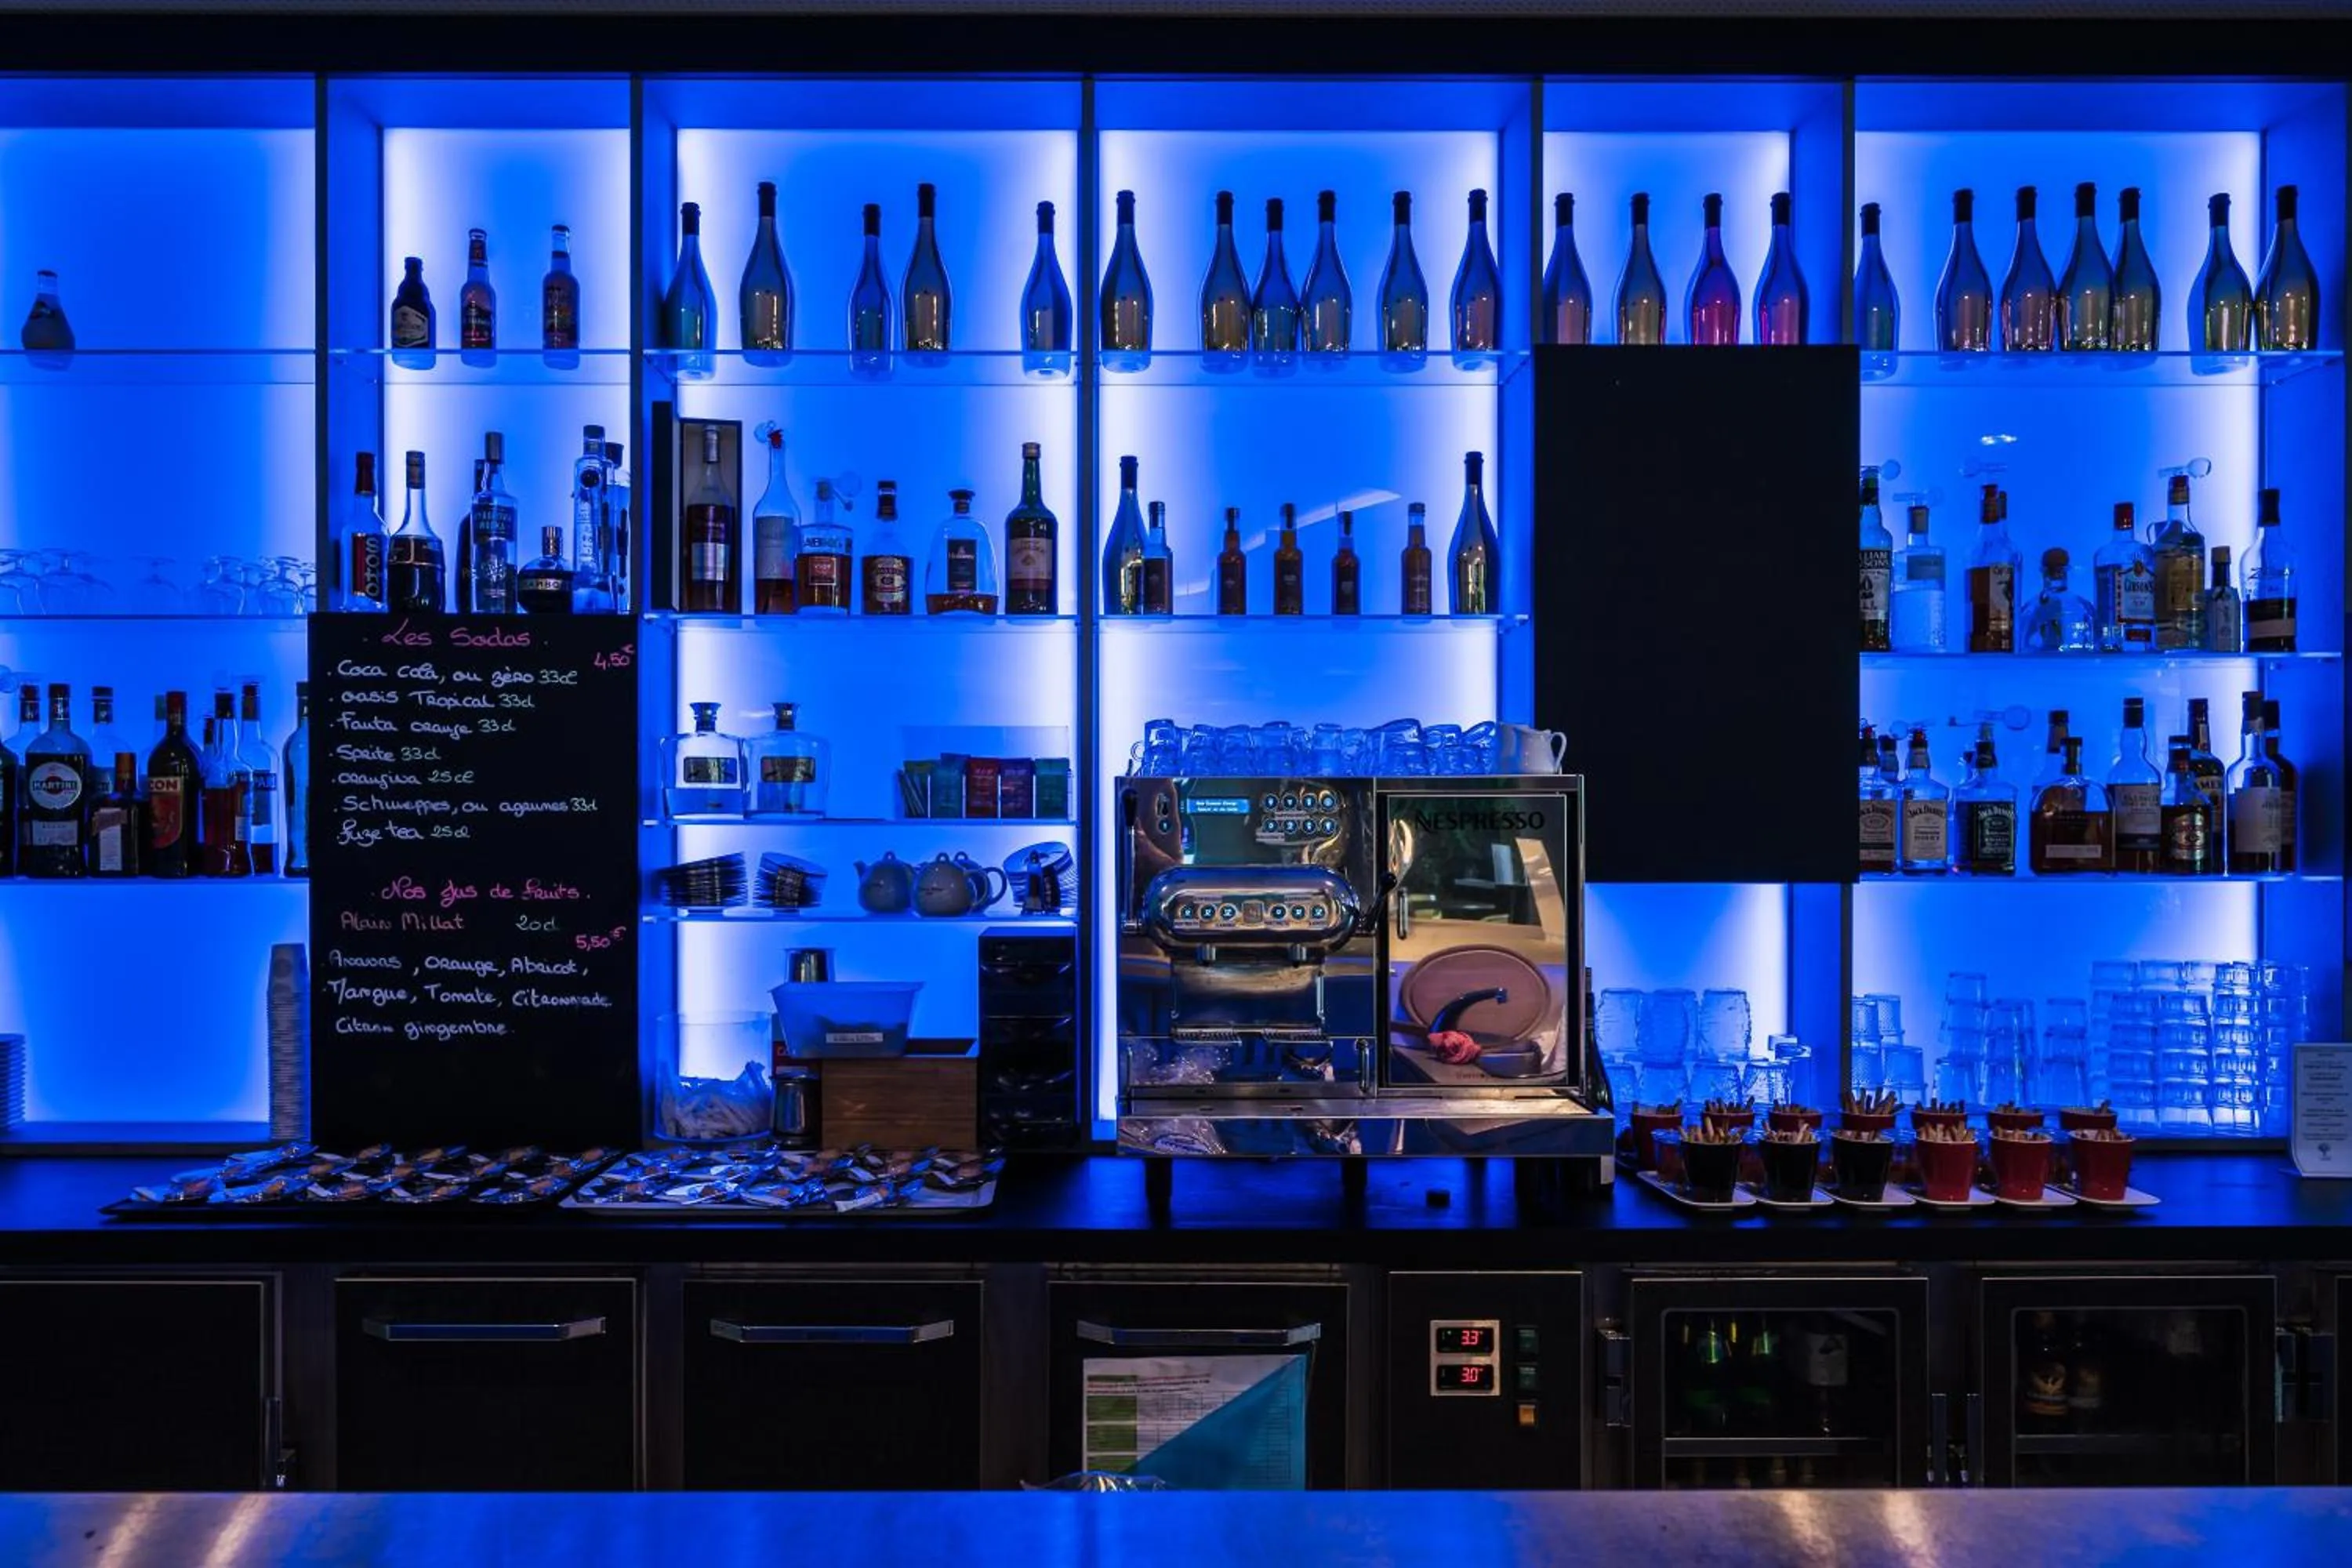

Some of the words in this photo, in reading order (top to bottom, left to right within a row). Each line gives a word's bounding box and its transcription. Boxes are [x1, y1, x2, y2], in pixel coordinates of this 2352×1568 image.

[381, 618, 432, 646] Les
[449, 626, 531, 647] Sodas
[337, 659, 388, 677] Coca
[452, 670, 483, 683] ou
[408, 688, 495, 710] Tropical
[336, 744, 396, 763] Sprite
[461, 801, 488, 813] ou
[384, 820, 425, 840] tea
[1414, 810, 1545, 833] NESPRESSO
[381, 876, 426, 899] Nos
[489, 883, 514, 898] de
[340, 911, 392, 931] Alain
[401, 912, 465, 930] Millat
